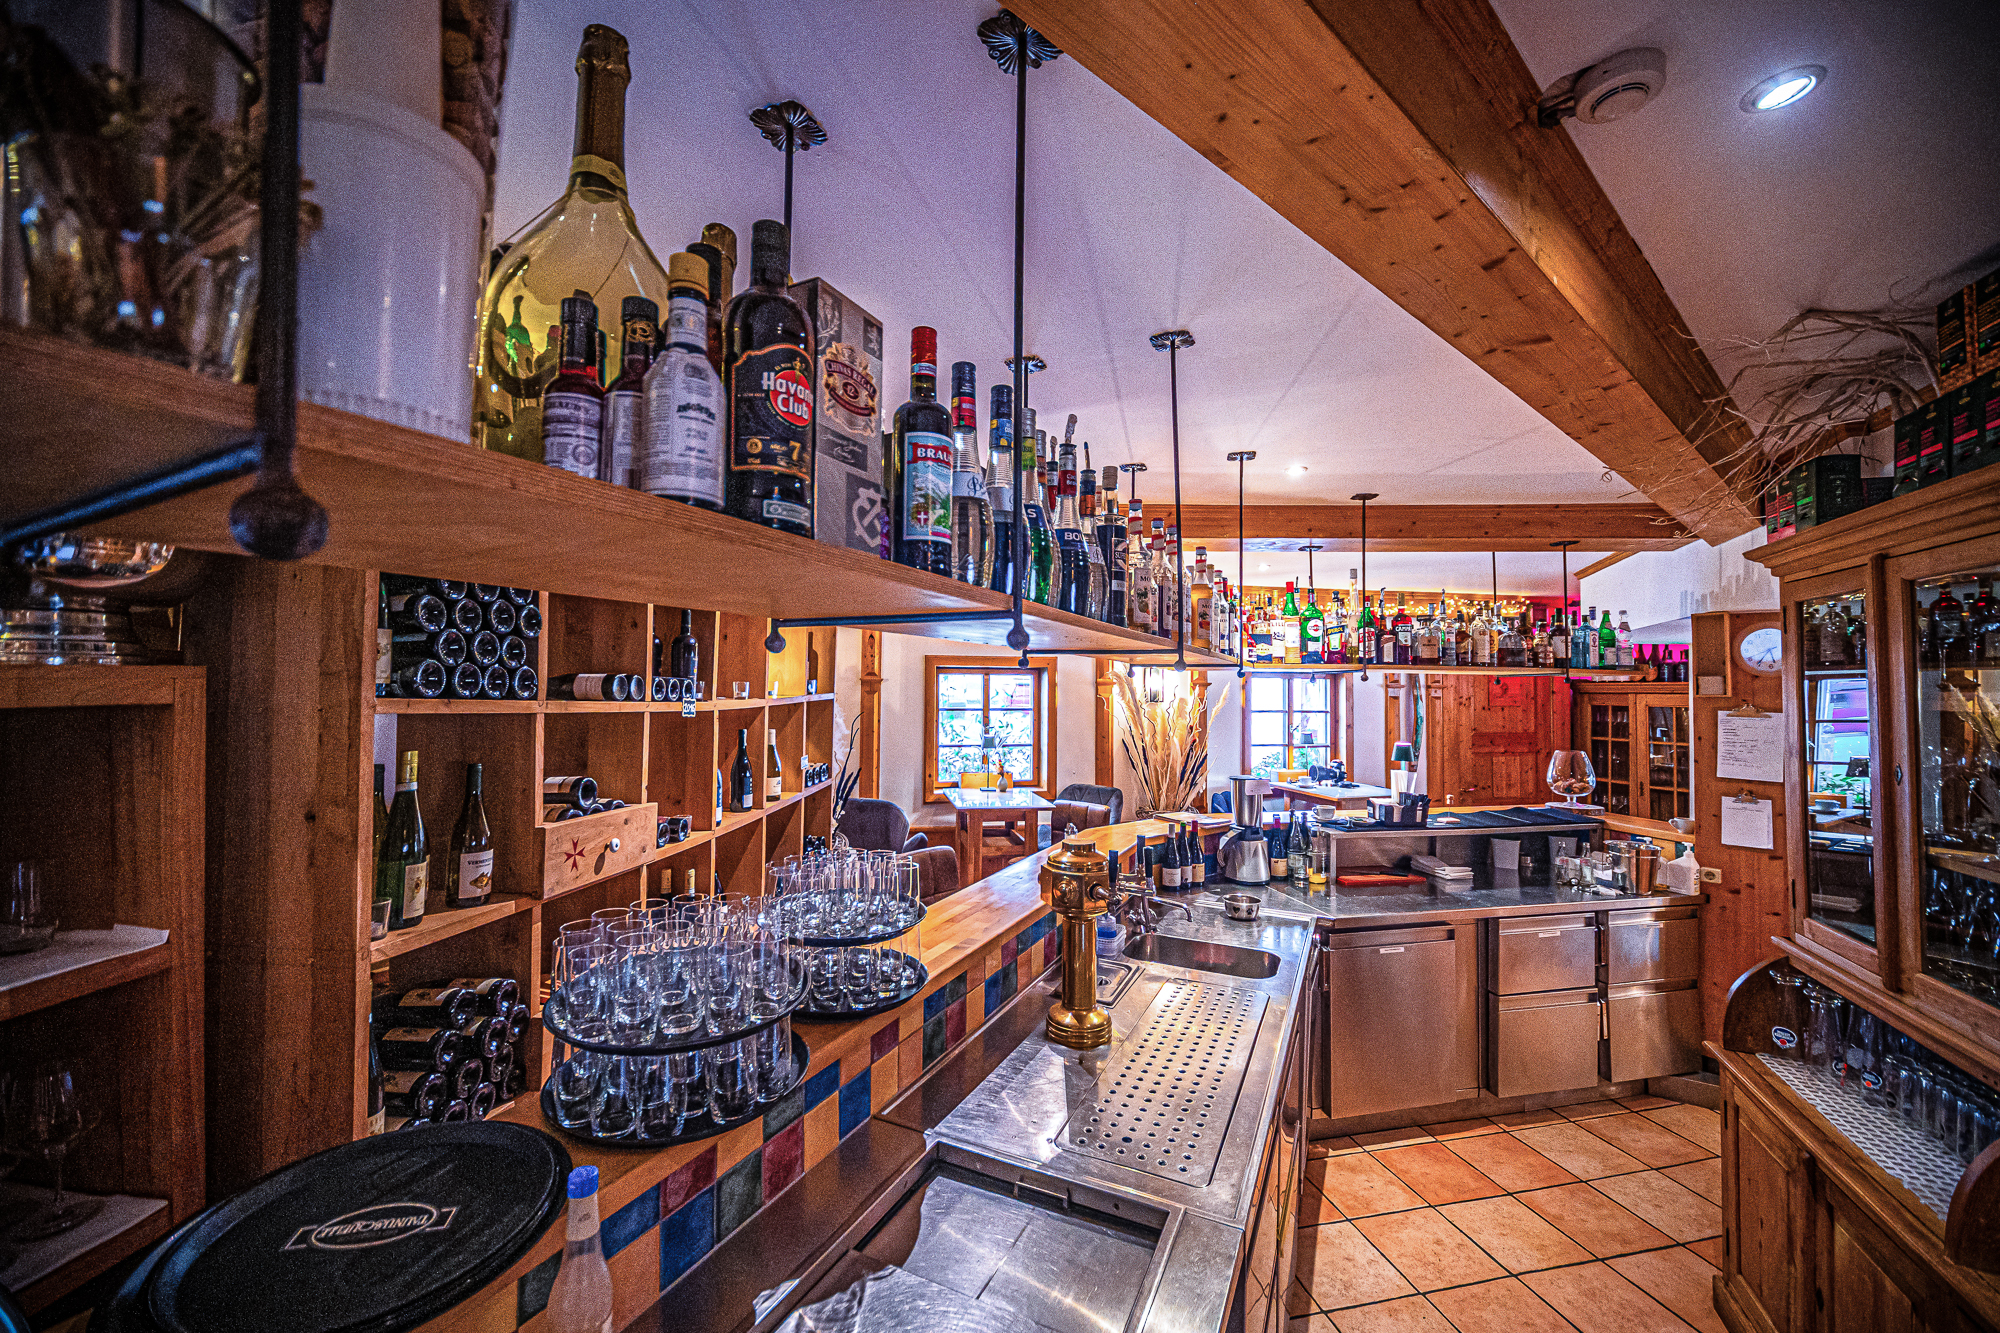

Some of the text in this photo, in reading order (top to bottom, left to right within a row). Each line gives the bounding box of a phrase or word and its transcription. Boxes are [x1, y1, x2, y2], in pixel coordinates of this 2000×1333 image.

[762, 371, 813, 408] Havan
[776, 393, 809, 420] Club
[789, 440, 801, 461] 7
[916, 447, 949, 462] BRAU
